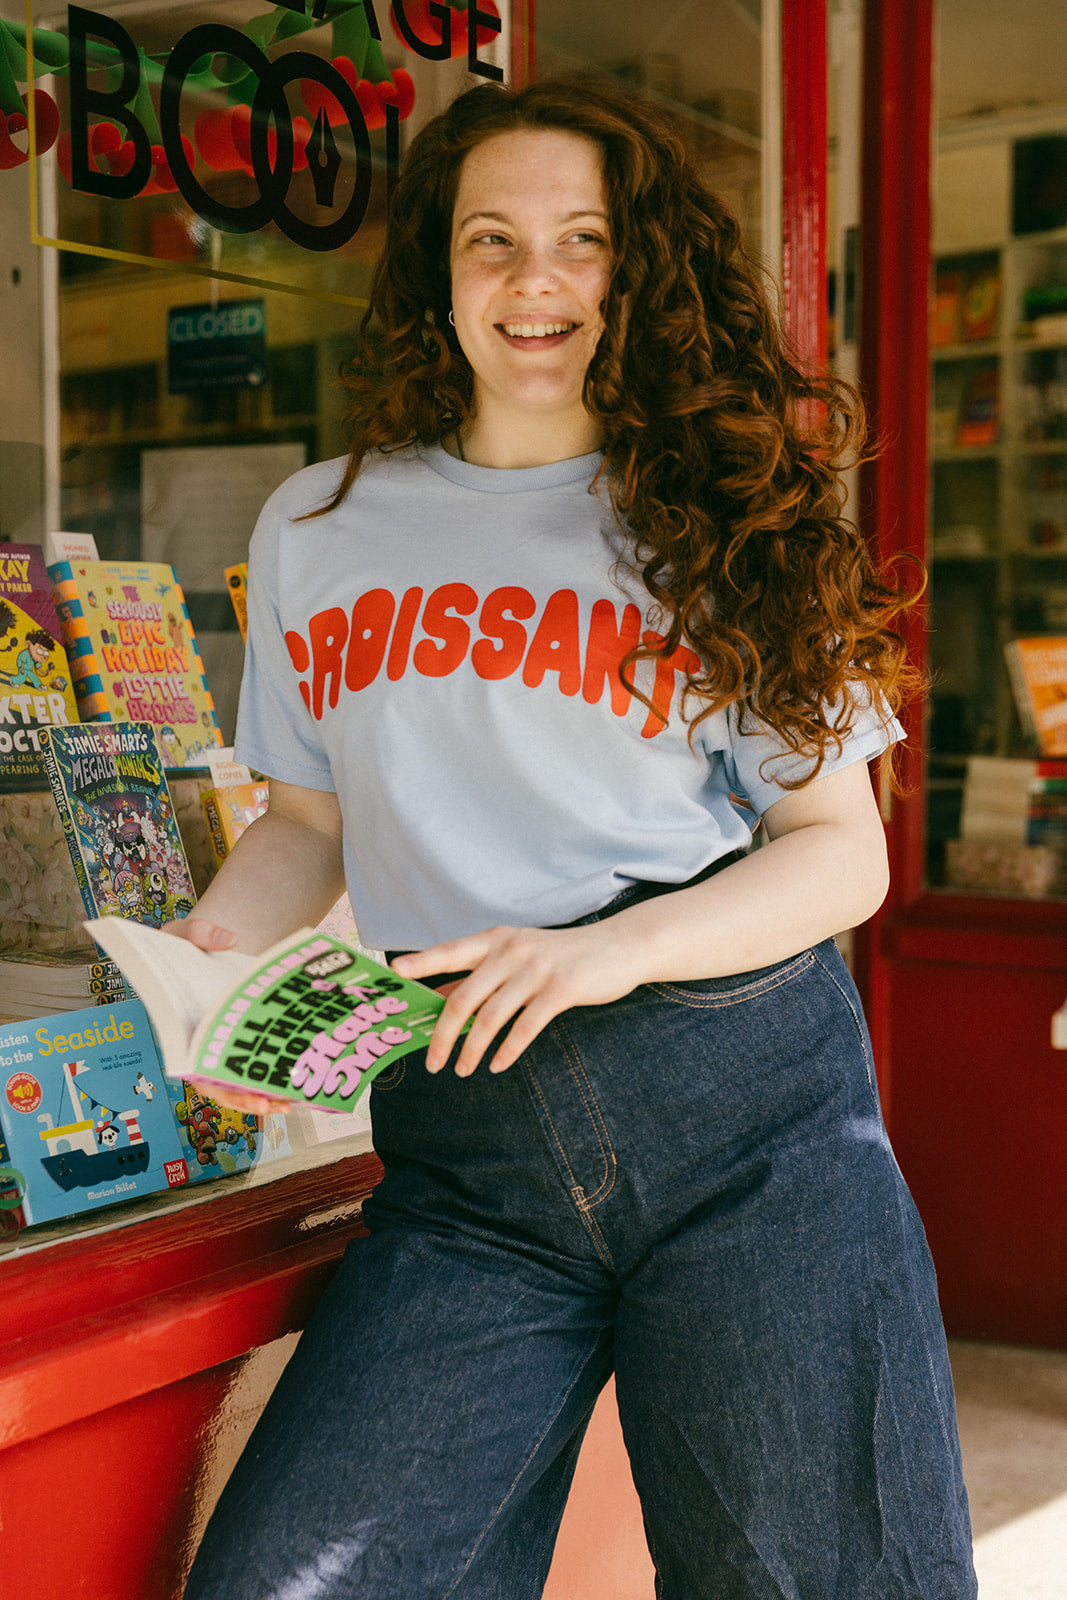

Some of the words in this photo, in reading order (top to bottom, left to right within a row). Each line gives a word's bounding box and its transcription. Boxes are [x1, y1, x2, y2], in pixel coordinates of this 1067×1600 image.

[68, 3, 399, 252] BOO
[168, 306, 264, 342] CLOSED
[106, 601, 162, 623] SERIOUSLY
[118, 621, 167, 647] EPIC
[102, 645, 190, 674] HOLIDAY
[123, 675, 190, 701] LOTTIE
[126, 700, 198, 725] BROOKS
[63, 735, 104, 755] JAMIE
[103, 731, 148, 752] SMART'S
[17, 754, 34, 763] CASE
[43, 750, 58, 778] JAMIE
[84, 790, 97, 803] THE
[130, 783, 156, 798] BEGINS
[213, 831, 226, 855] PETS
[35, 1014, 134, 1056] Seaside
[247, 985, 346, 1082] OTHER
[0, 1055, 13, 1067] to
[13, 1049, 33, 1064] the
[99, 1056, 113, 1064] With
[119, 1050, 142, 1060] amazing
[224, 1018, 274, 1077] ALL
[323, 1026, 413, 1098] Me
[22, 1074, 36, 1085] BOOK
[13, 1101, 26, 1111] LOOK
[166, 1161, 184, 1174] nosy
[87, 1188, 115, 1200] Marion
[115, 1181, 138, 1193] Billet
